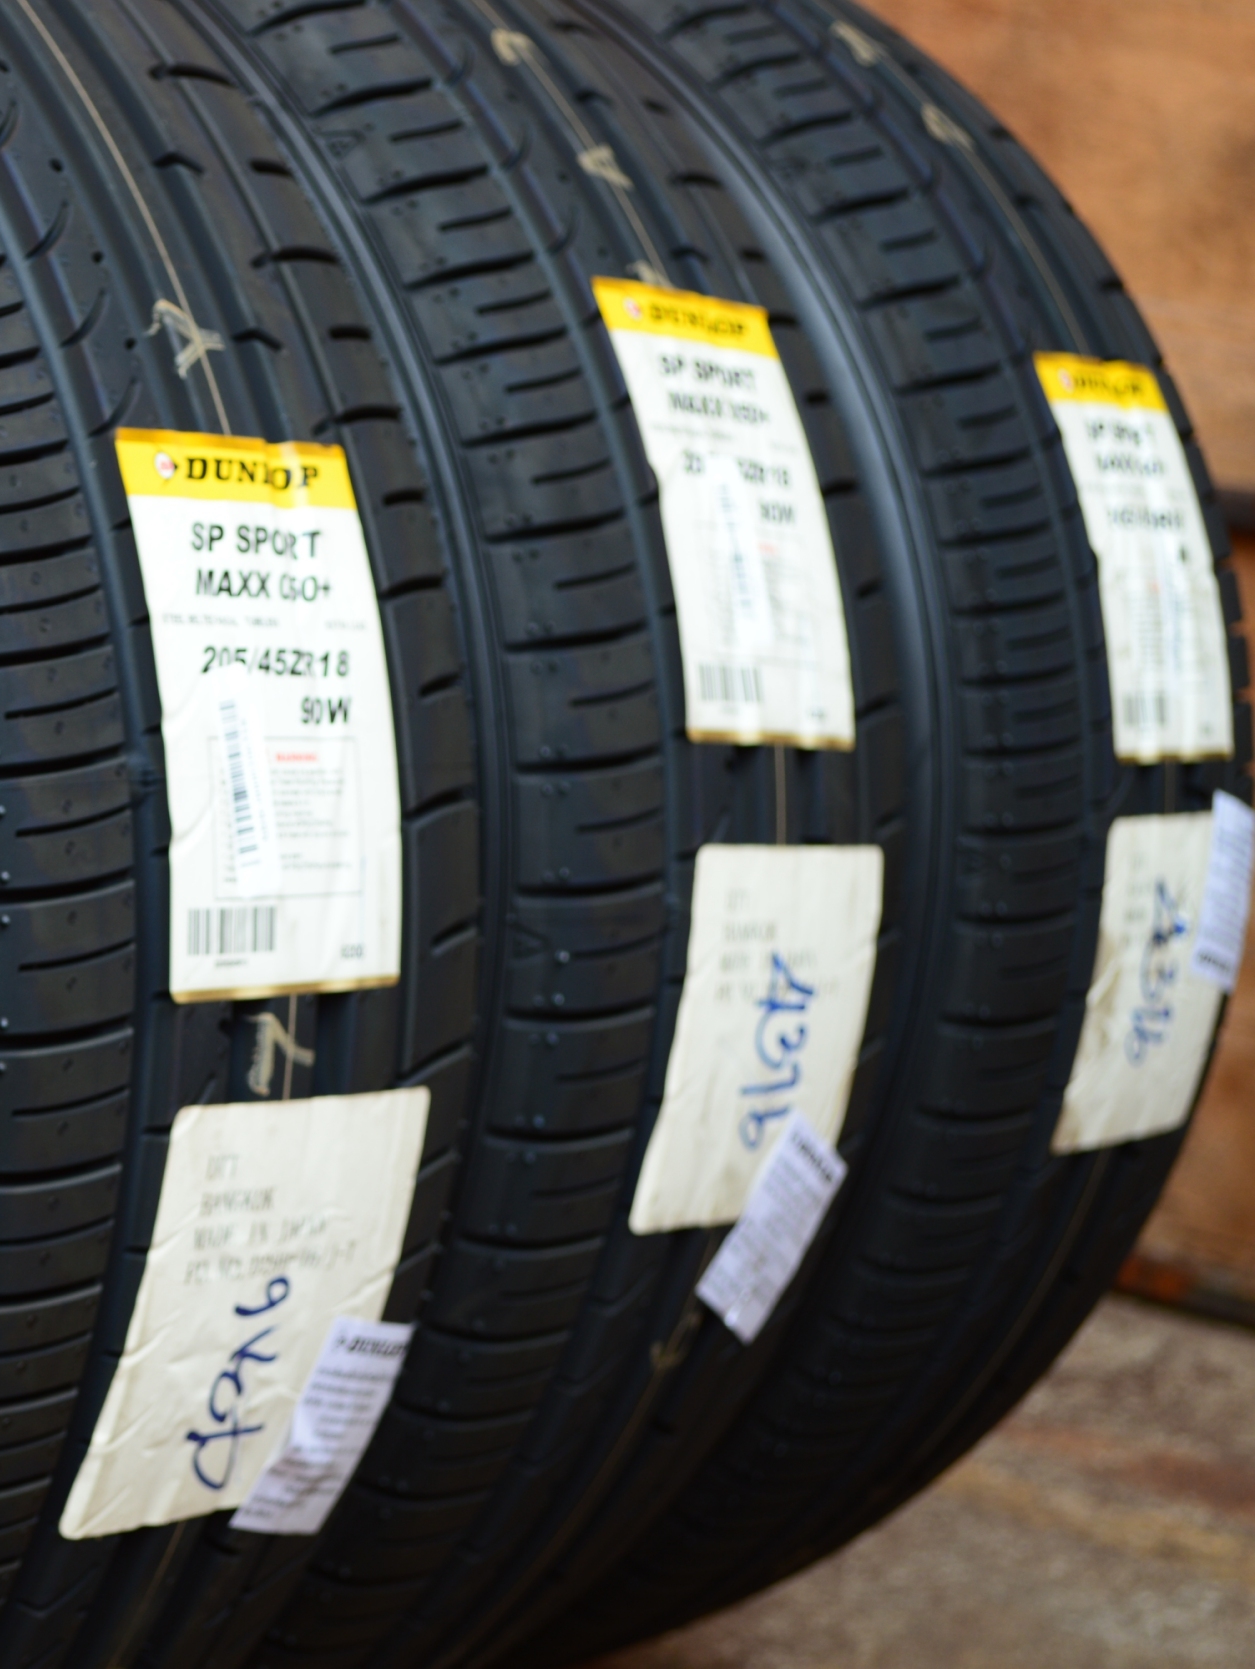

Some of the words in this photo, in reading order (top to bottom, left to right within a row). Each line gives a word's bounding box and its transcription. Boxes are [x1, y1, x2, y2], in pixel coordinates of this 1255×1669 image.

[186, 456, 319, 491] DUNLOP
[191, 521, 225, 552] SP
[236, 524, 321, 560] SPORT
[195, 567, 271, 599] MAXX
